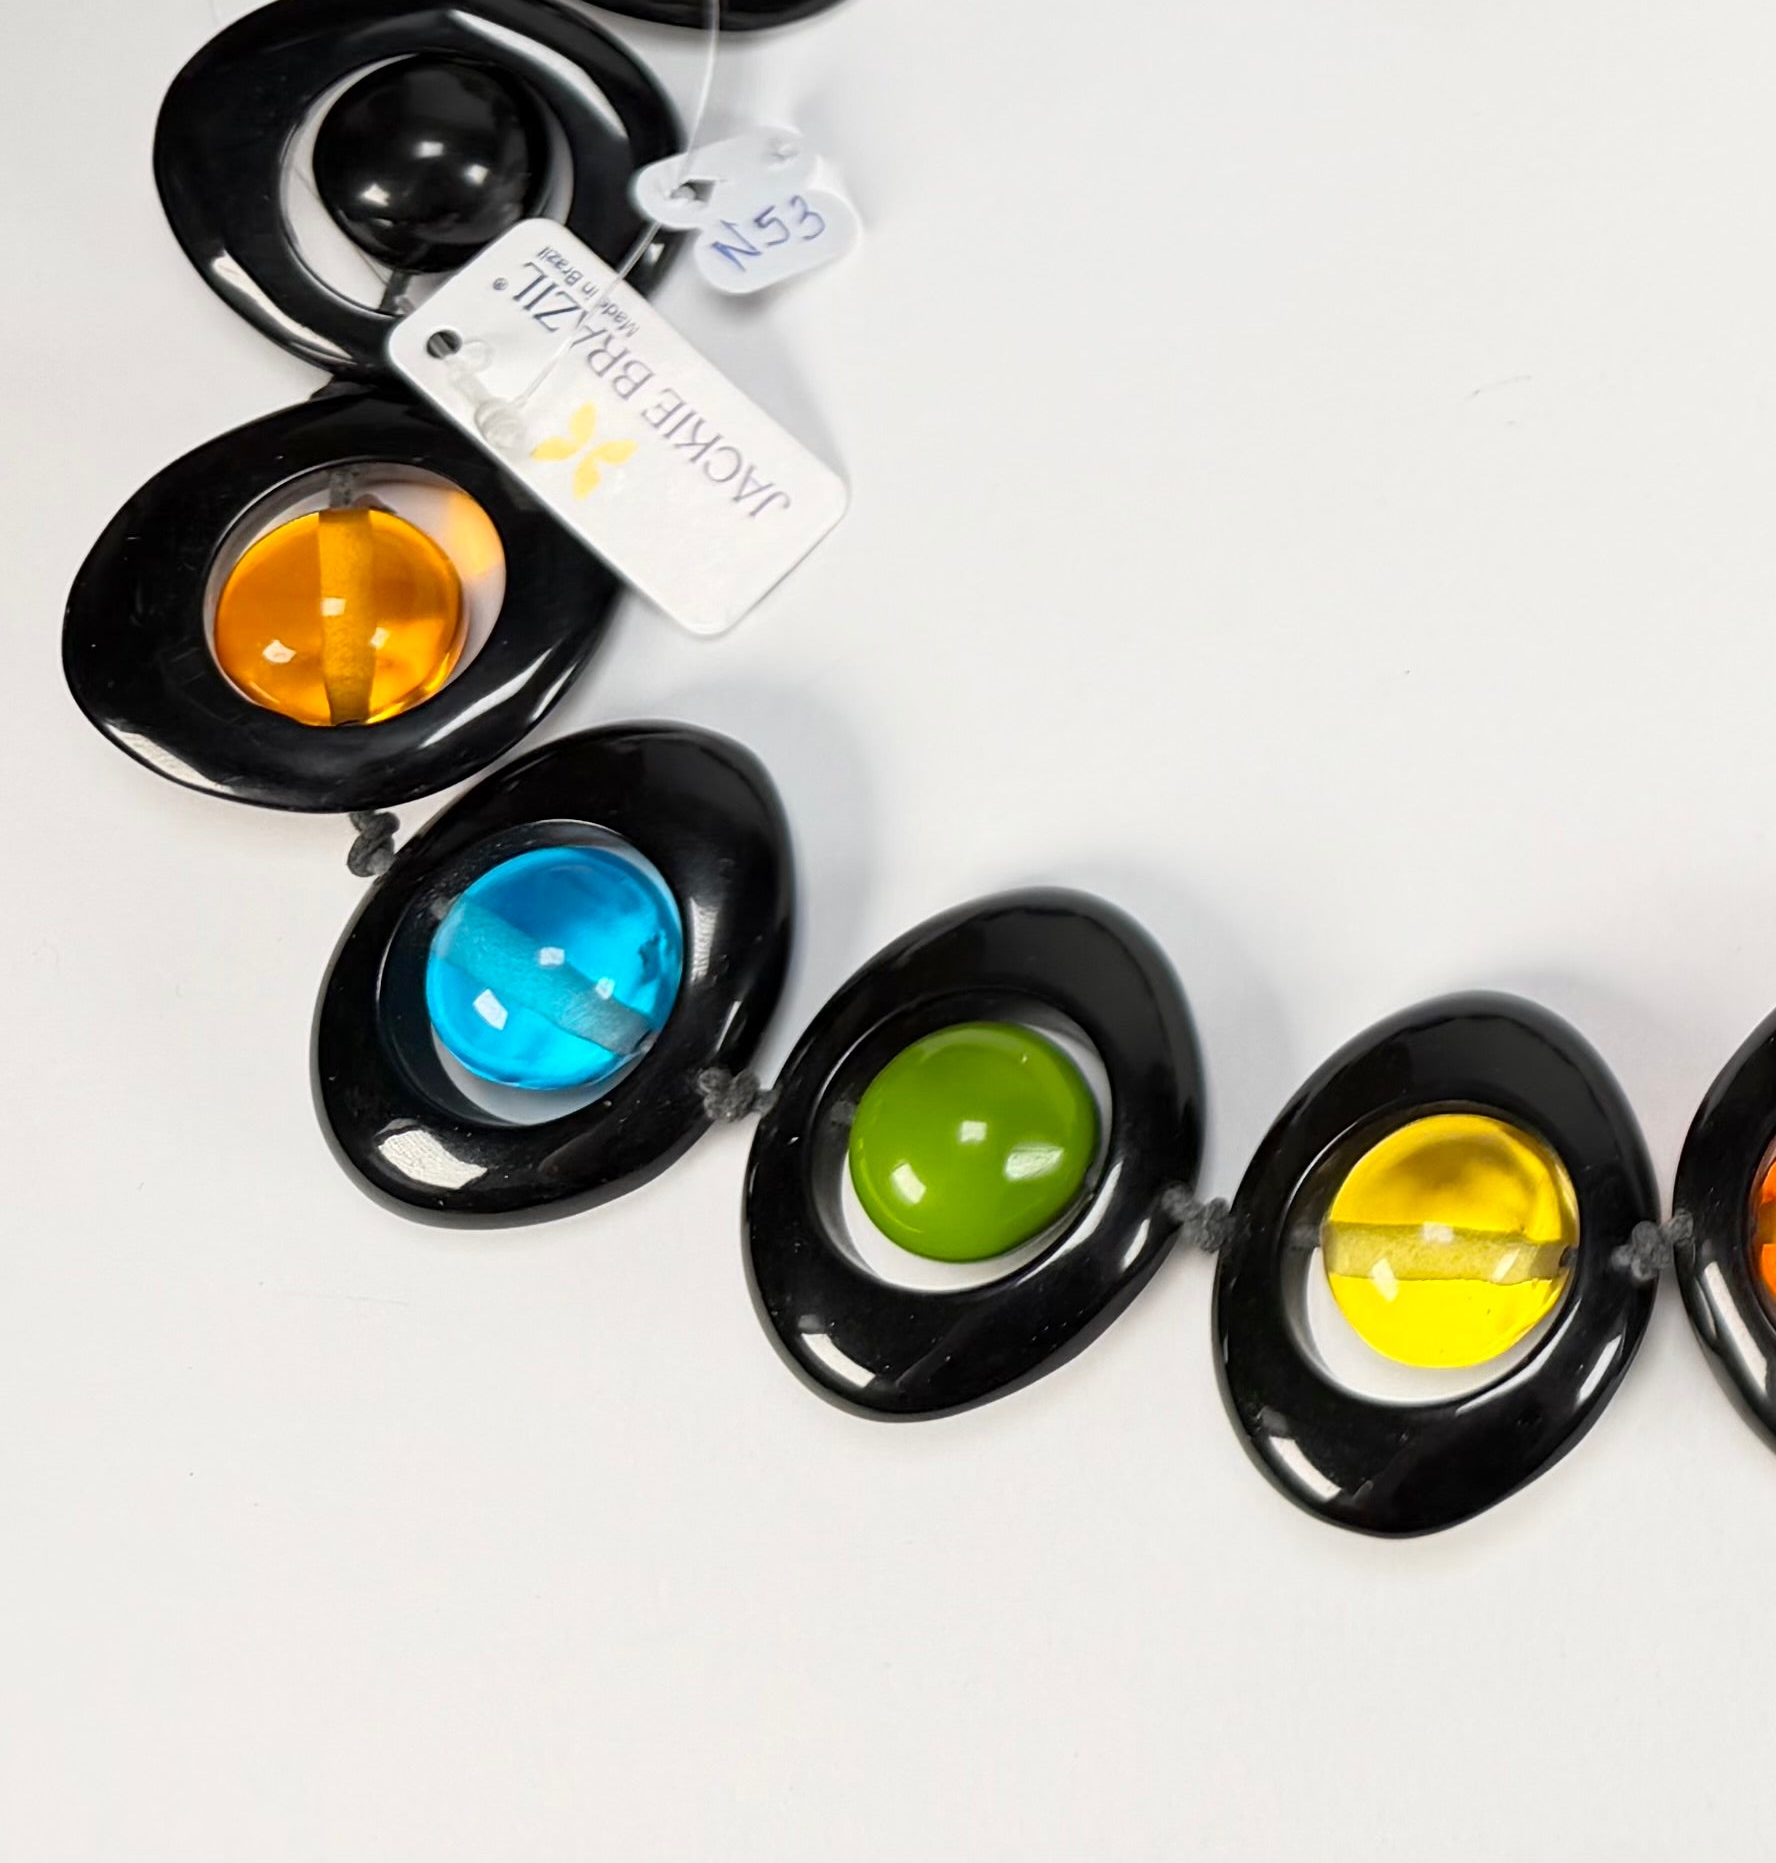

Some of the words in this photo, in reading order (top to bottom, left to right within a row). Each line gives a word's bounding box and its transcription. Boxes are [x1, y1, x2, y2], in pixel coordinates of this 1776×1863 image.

[710, 194, 827, 273] N53
[536, 245, 584, 287] Brazil
[581, 280, 599, 301] in
[598, 297, 641, 339] Made
[640, 387, 791, 518] JACKIE
